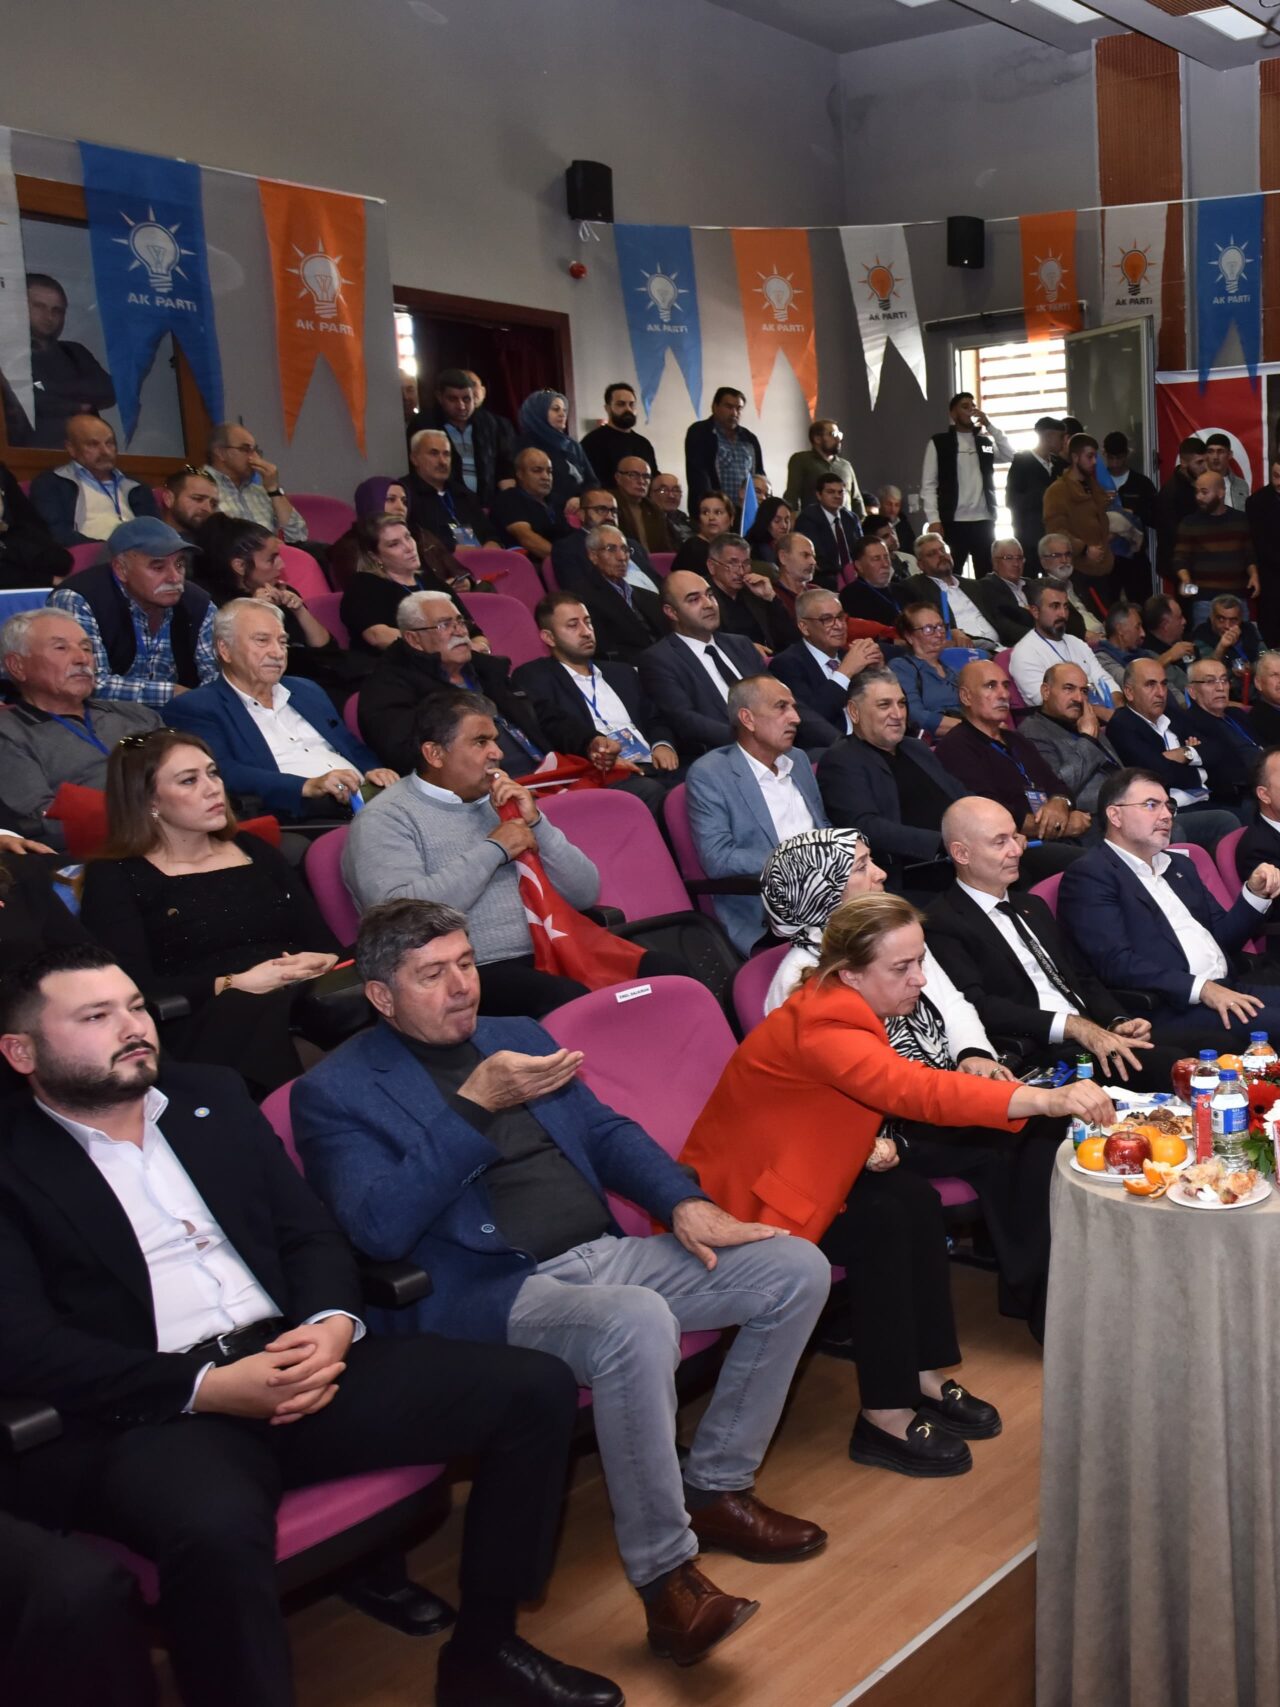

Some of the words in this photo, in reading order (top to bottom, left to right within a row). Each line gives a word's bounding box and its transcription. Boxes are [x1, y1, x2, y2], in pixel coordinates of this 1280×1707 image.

[128, 292, 151, 306] AK
[1115, 297, 1127, 306] AK
[1212, 296, 1225, 305] AK
[869, 313, 880, 321] AK
[296, 319, 315, 331] AK
[646, 323, 661, 332] AK
[762, 323, 776, 332] AK
